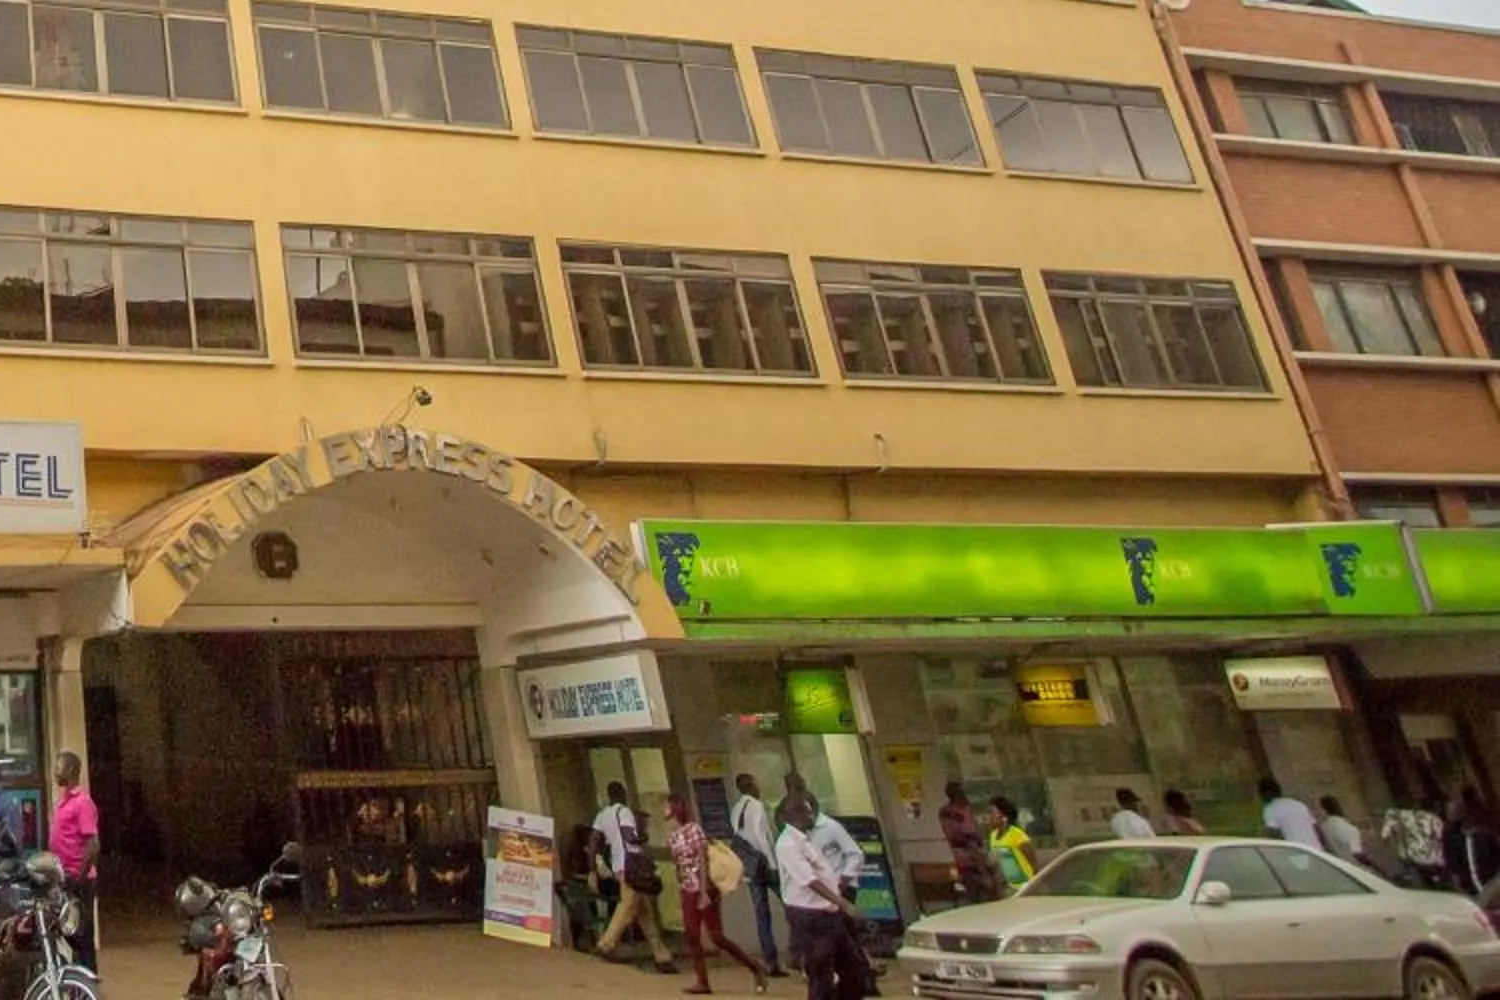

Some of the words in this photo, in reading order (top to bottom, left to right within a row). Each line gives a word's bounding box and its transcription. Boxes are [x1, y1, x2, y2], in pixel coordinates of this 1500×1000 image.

[160, 446, 313, 592] HOLIDAY
[322, 423, 515, 495] EXPRESS
[522, 473, 640, 606] HOTEL
[700, 554, 740, 579] KCB
